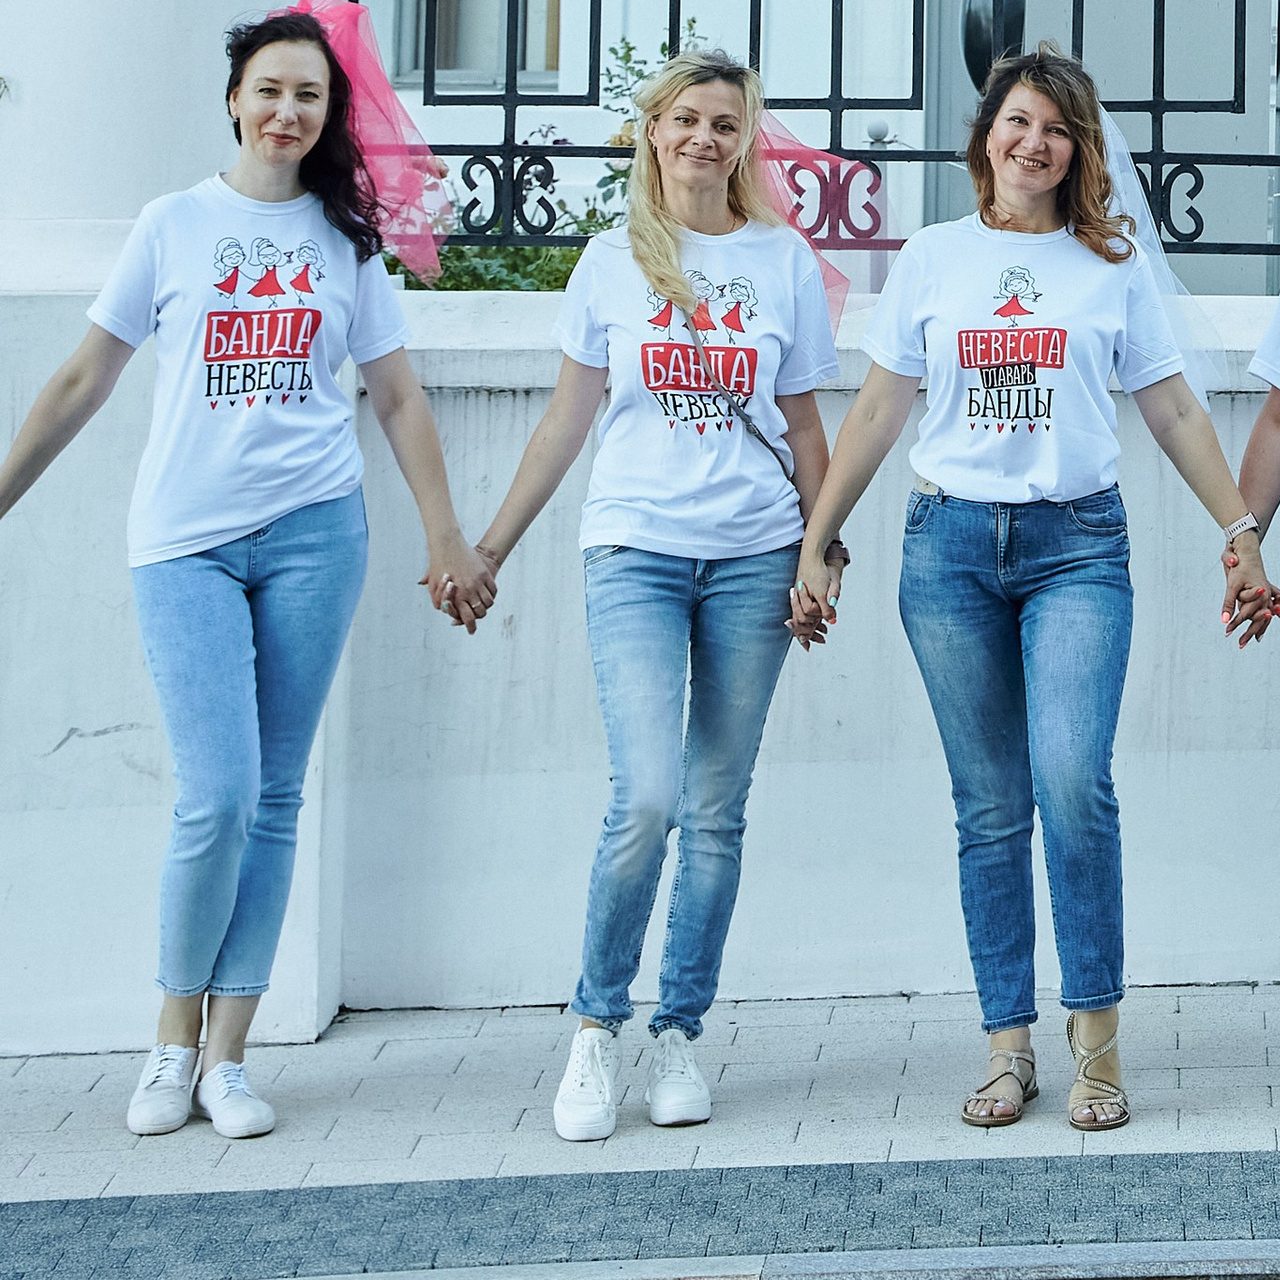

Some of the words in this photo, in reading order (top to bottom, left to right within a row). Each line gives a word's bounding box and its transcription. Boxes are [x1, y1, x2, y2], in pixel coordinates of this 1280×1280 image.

[206, 310, 313, 358] БАНДА
[960, 329, 1062, 368] НЕВЕСТА
[981, 363, 1035, 388] ГЛАВАРЬ
[967, 387, 1054, 423] БАНДЫ
